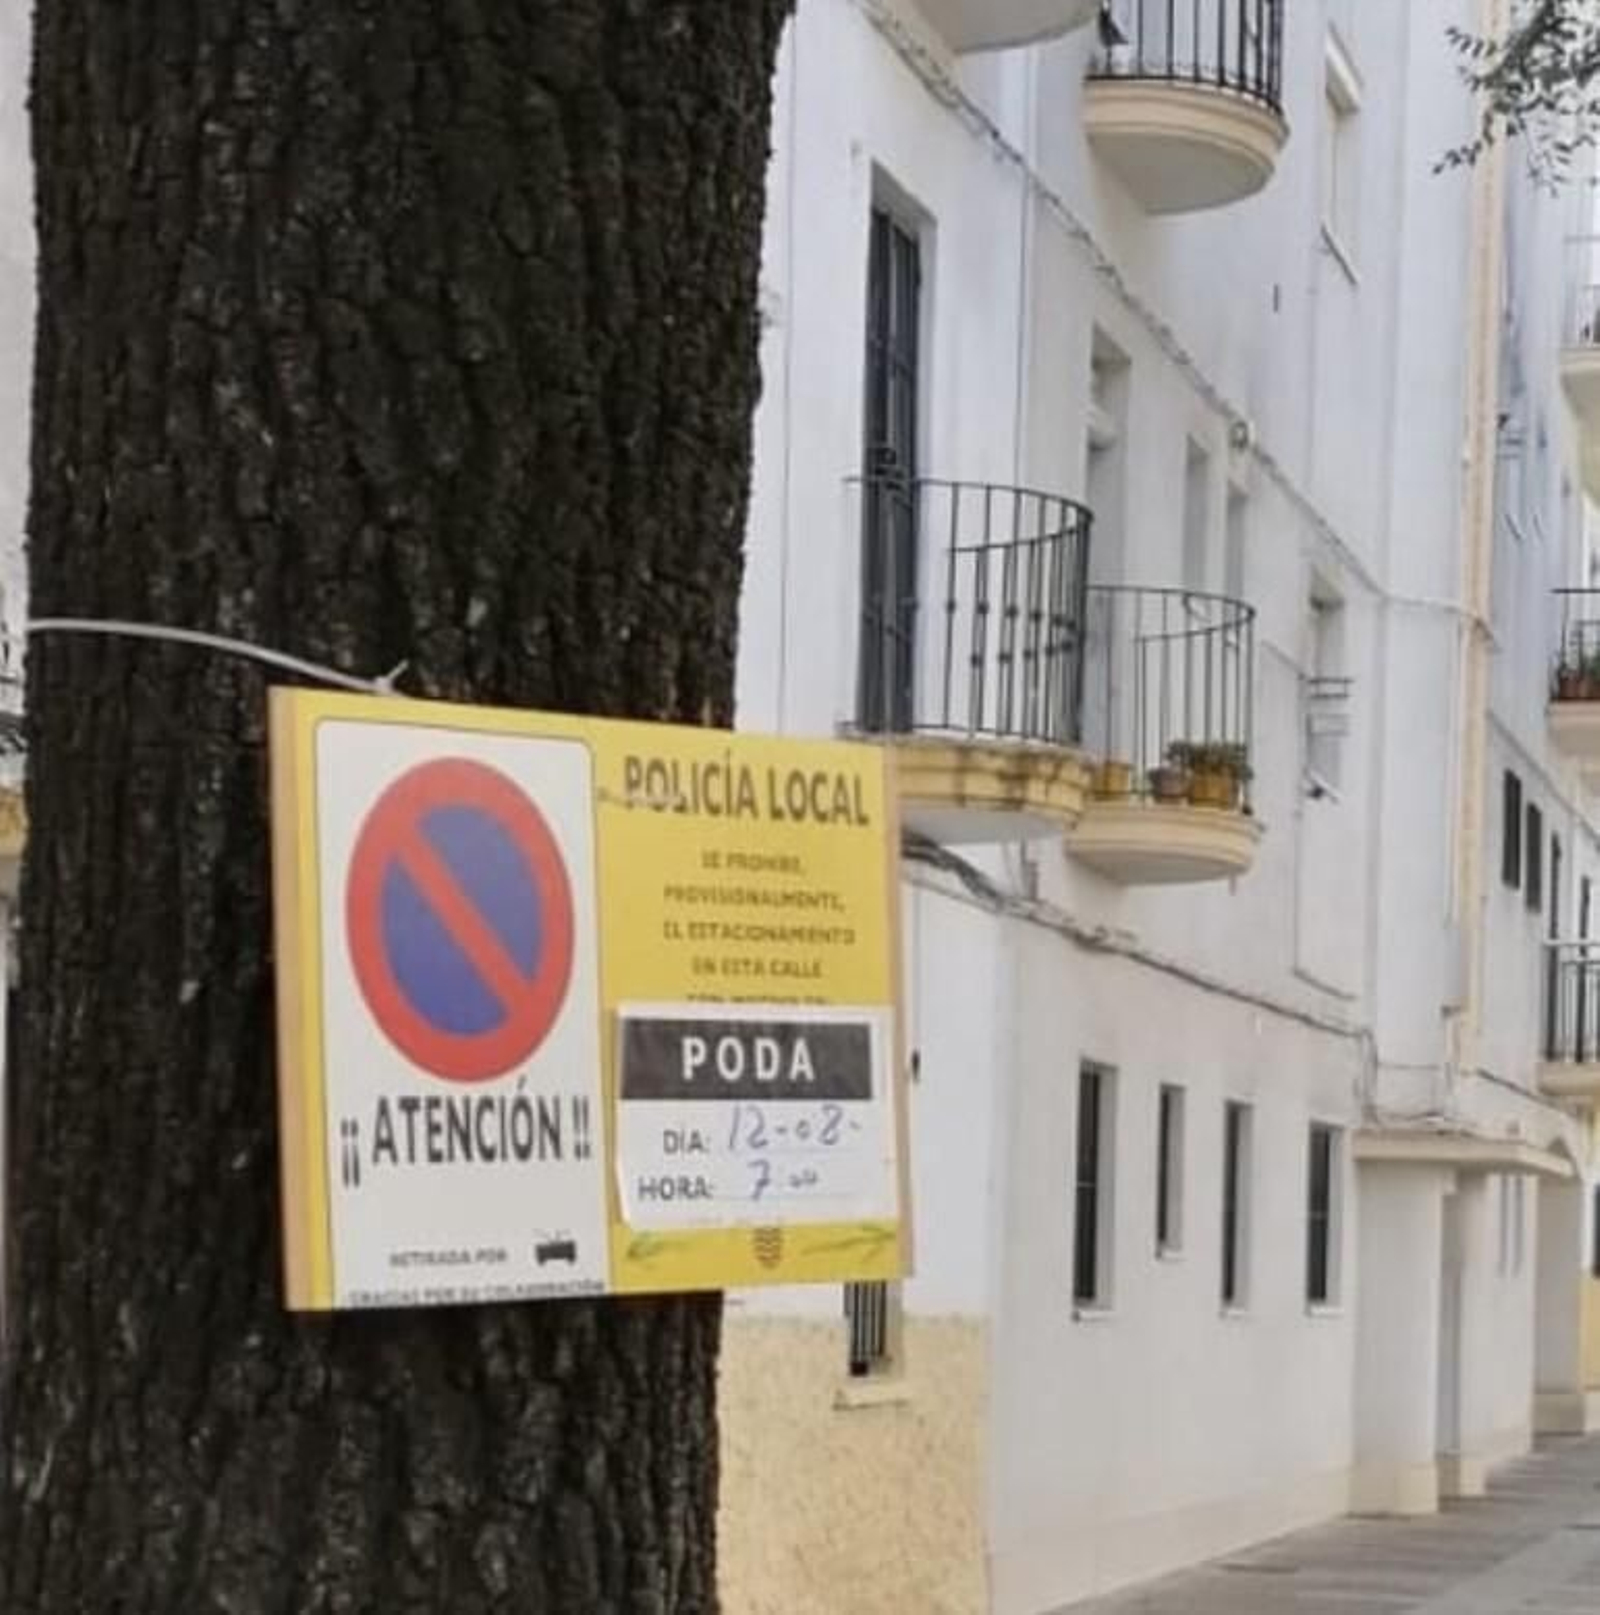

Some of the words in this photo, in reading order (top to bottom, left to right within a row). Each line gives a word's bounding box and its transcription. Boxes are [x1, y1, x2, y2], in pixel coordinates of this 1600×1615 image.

[623, 748, 759, 819] POLICÍA
[767, 768, 870, 826] LOCAL
[770, 961, 823, 979] CALLE
[682, 1036, 816, 1081] PODA
[371, 1075, 562, 1165] ATENCIÓN
